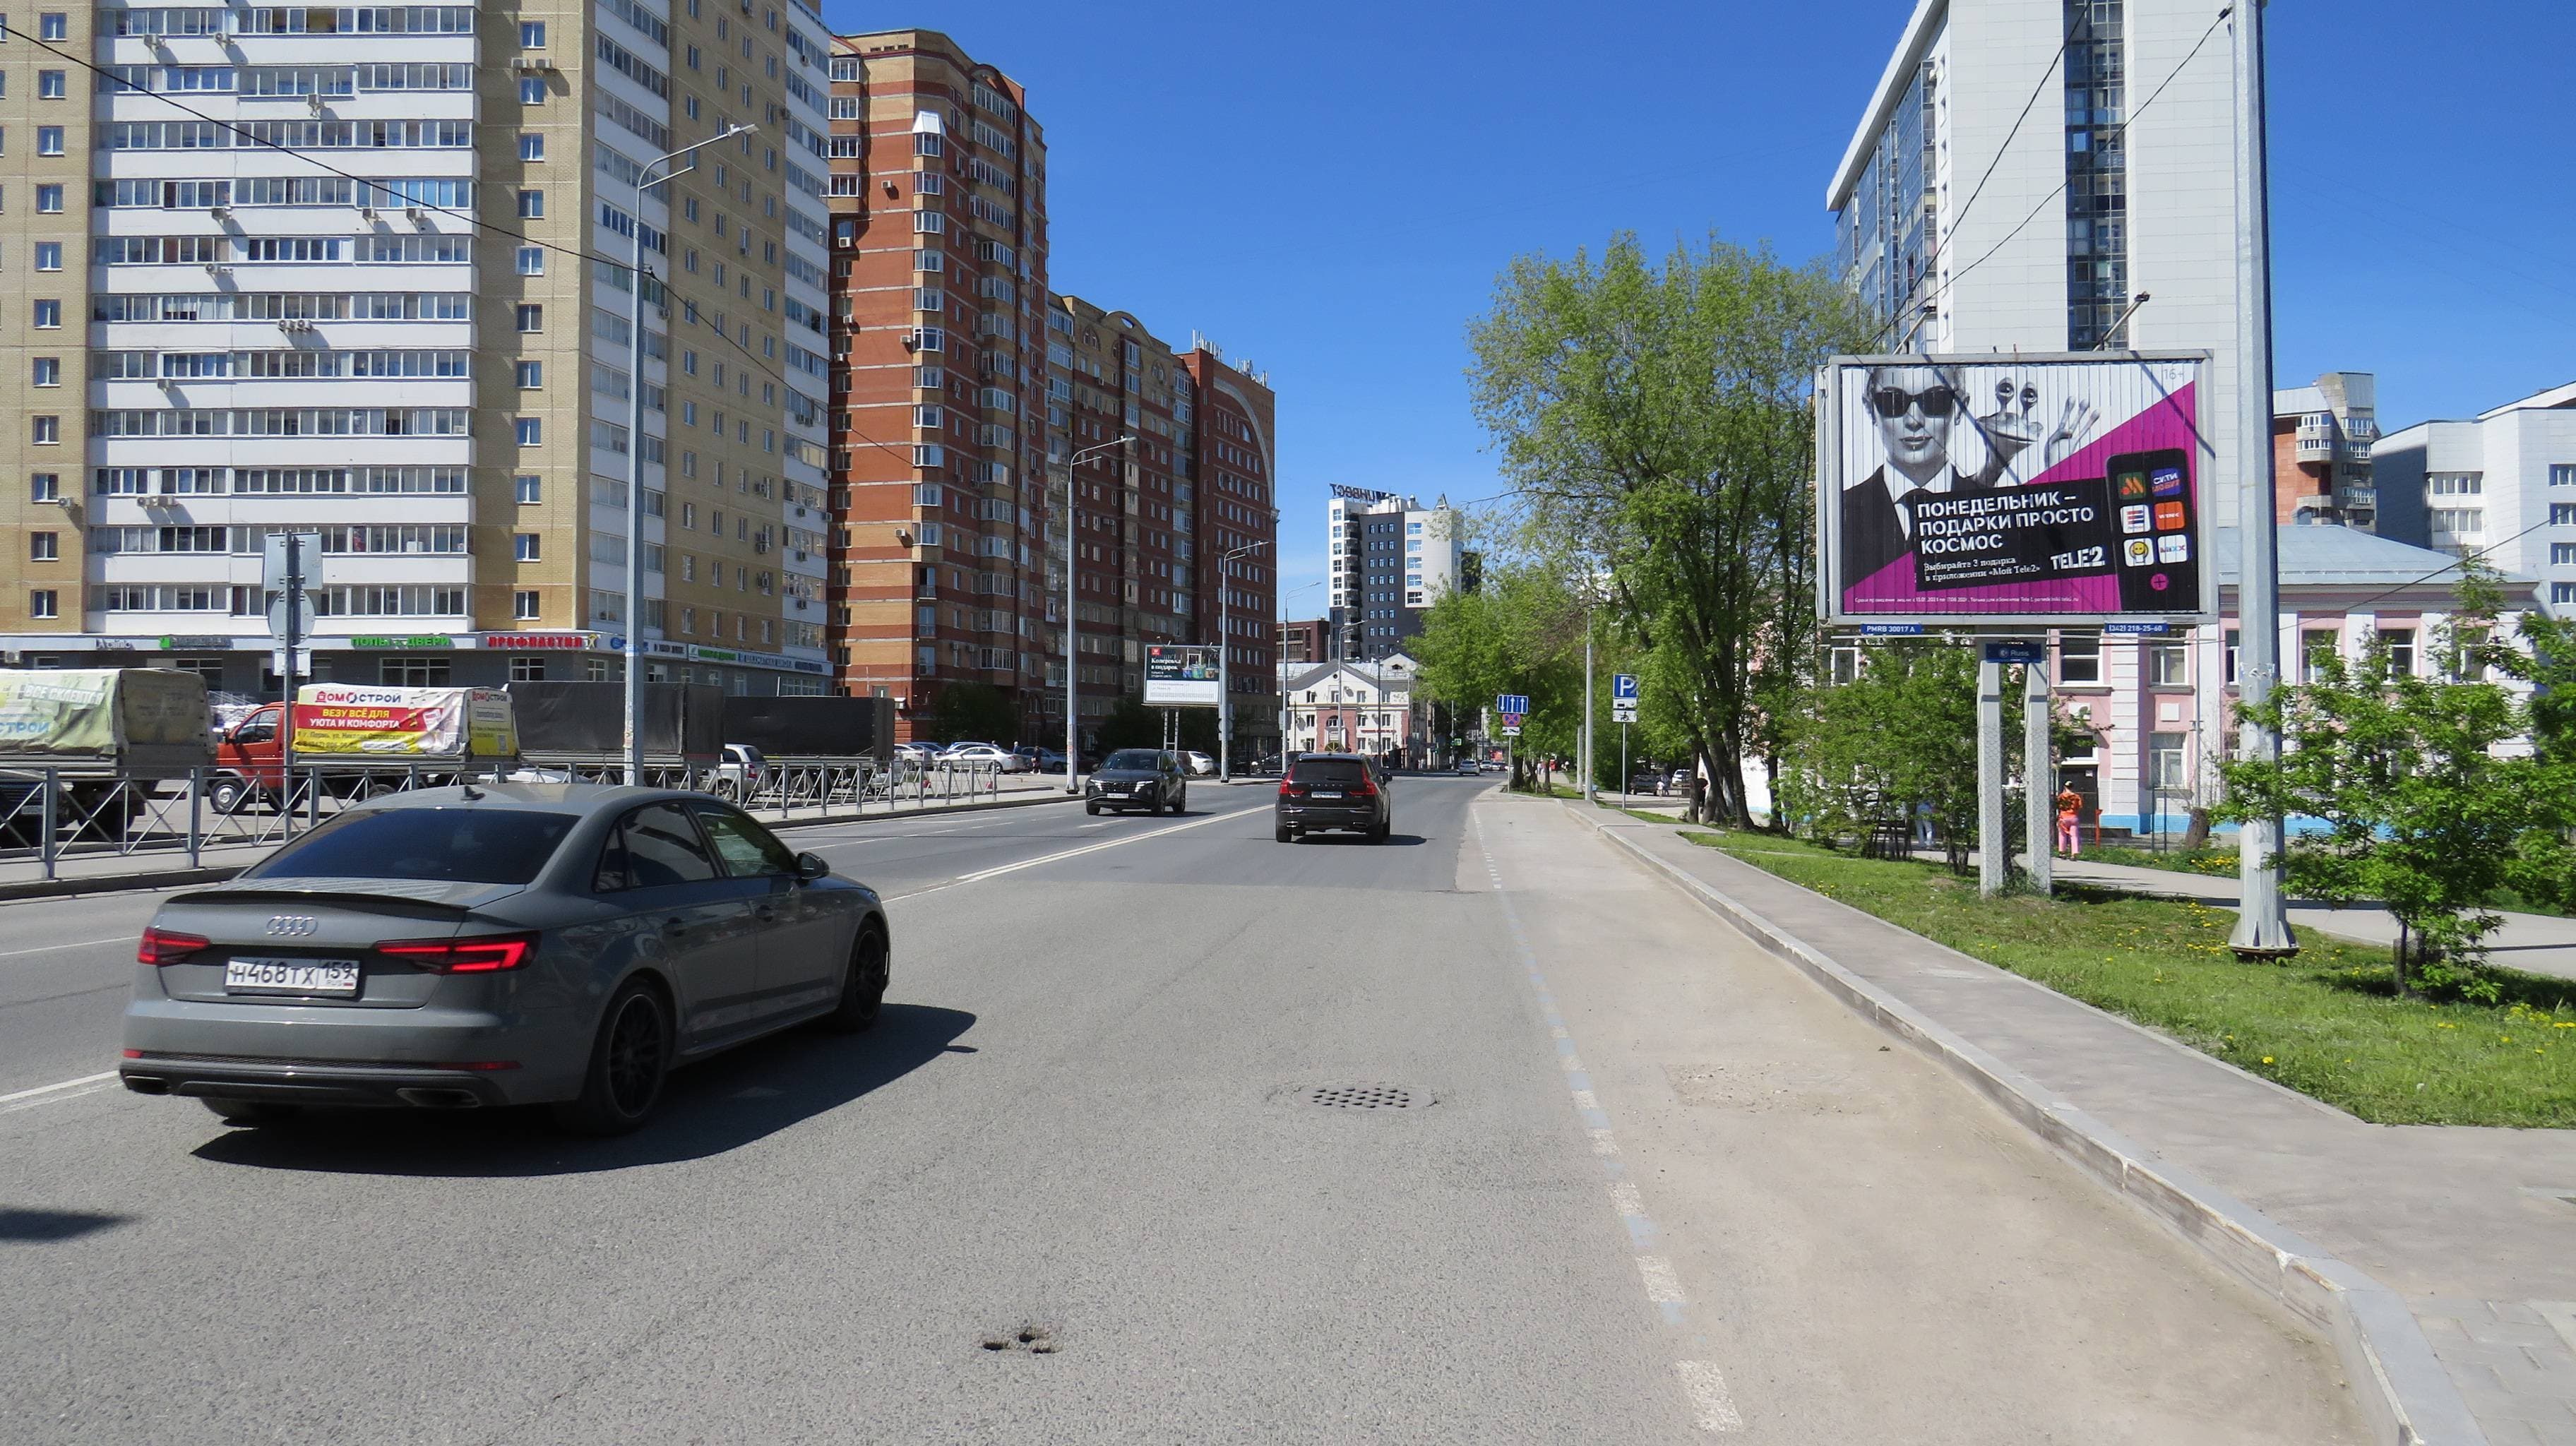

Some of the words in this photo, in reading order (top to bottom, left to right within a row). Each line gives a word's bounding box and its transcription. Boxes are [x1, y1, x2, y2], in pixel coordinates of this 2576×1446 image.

[2164, 369, 2183, 379] 16+
[1917, 491, 2060, 518] ПОНЕДЕЛЬНИК
[1919, 515, 2011, 537] ПОДАРКИ
[2016, 507, 2094, 527] ПРОСТО
[1921, 534, 2004, 554] КОСМОС
[1924, 561, 1971, 571] Выбирайте
[1972, 558, 1978, 567] 3
[1980, 558, 2016, 567] подарка
[2050, 546, 2105, 570] TELE2
[1932, 570, 1987, 582] приложении
[2014, 564, 2040, 573] Tele2»
[407, 636, 451, 647] ДВЕРИ
[322, 708, 347, 717] ВЕЗУ
[349, 708, 367, 718] ВСЁ
[368, 710, 390, 719] ДЛЯ
[310, 719, 335, 727] УЮТА
[338, 719, 345, 727] И
[347, 719, 400, 729] КОМФОРТА
